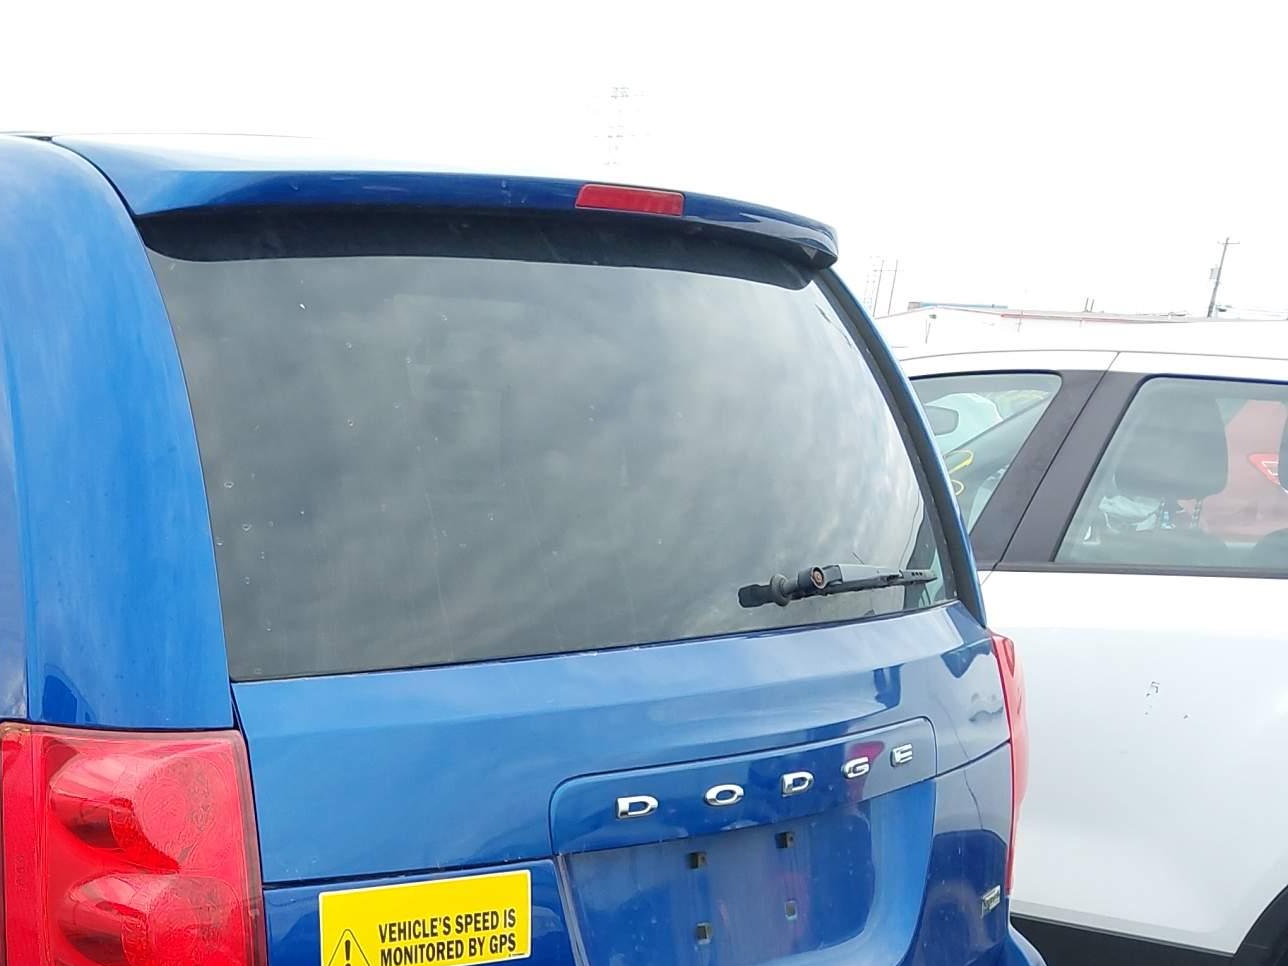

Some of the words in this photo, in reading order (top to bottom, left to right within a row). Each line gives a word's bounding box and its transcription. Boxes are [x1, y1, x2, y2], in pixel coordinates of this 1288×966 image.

[616, 743, 913, 819] DODGE
[378, 916, 452, 943] VEHICLE'S
[455, 910, 499, 934] SPEED
[503, 908, 516, 928] IS
[469, 936, 486, 957] BY
[489, 933, 516, 954] GPS
